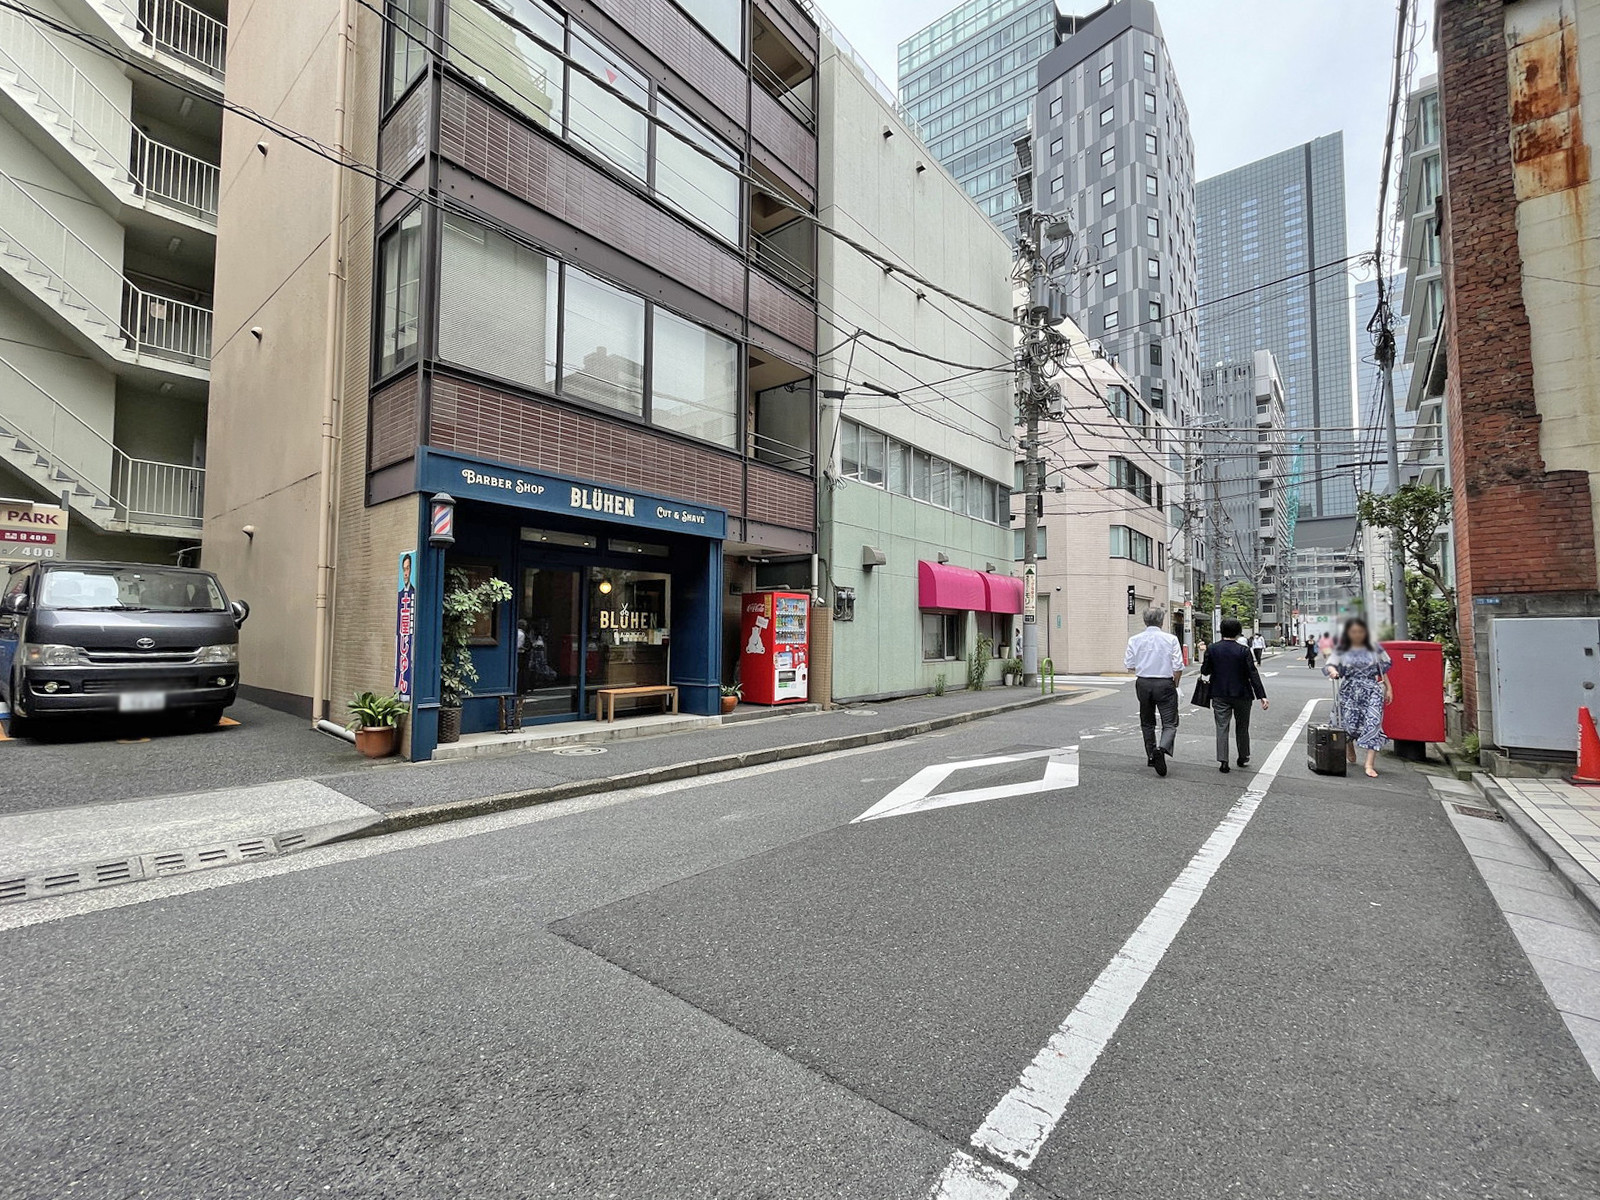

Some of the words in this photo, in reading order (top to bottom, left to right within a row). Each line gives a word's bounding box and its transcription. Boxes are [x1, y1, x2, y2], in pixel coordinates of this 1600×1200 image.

[461, 469, 512, 489] BARBER
[515, 480, 545, 495] SHOP
[570, 486, 636, 517] BLÜHEN
[7, 510, 59, 525] PARK
[656, 506, 672, 518] CUT
[673, 511, 680, 520] &
[681, 510, 705, 524] SHAVE
[22, 547, 54, 558] 400
